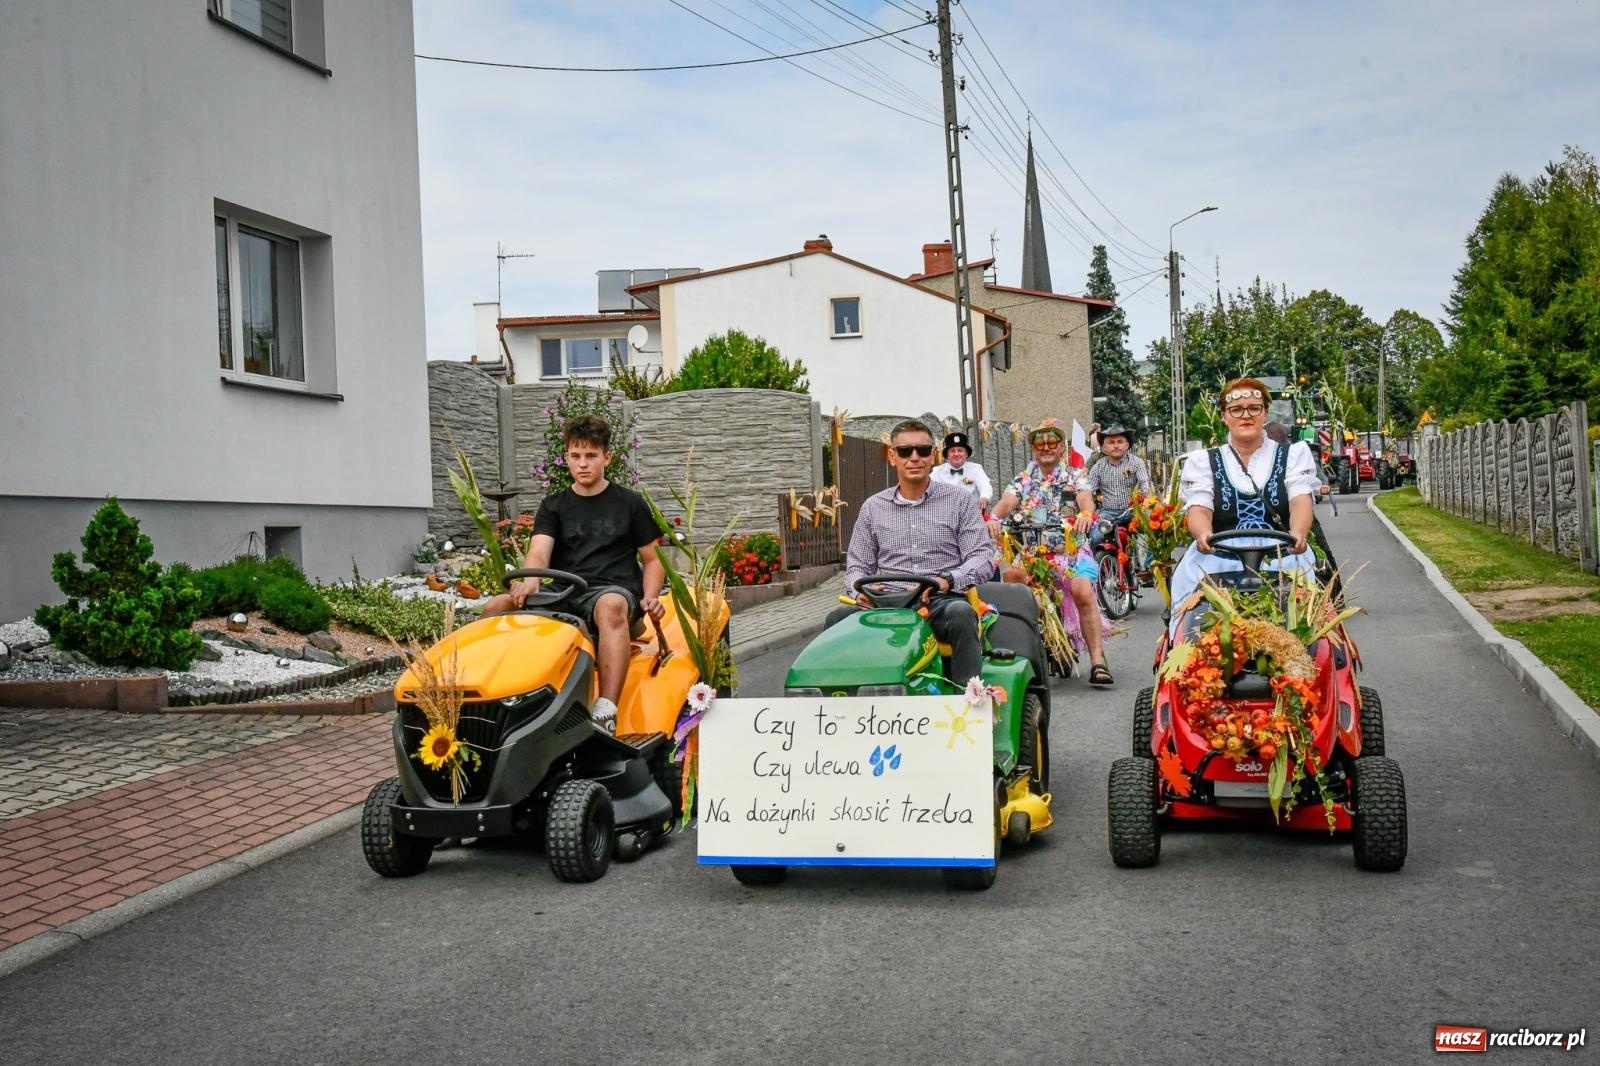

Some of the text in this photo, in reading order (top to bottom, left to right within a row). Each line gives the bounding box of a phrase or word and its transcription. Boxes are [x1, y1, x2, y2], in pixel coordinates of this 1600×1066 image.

[754, 705, 929, 751] Czy to słońce
[754, 751, 860, 793] Czy ulewa
[1235, 760, 1263, 772] solo
[705, 793, 972, 834] Na dożynki skosić trzeba
